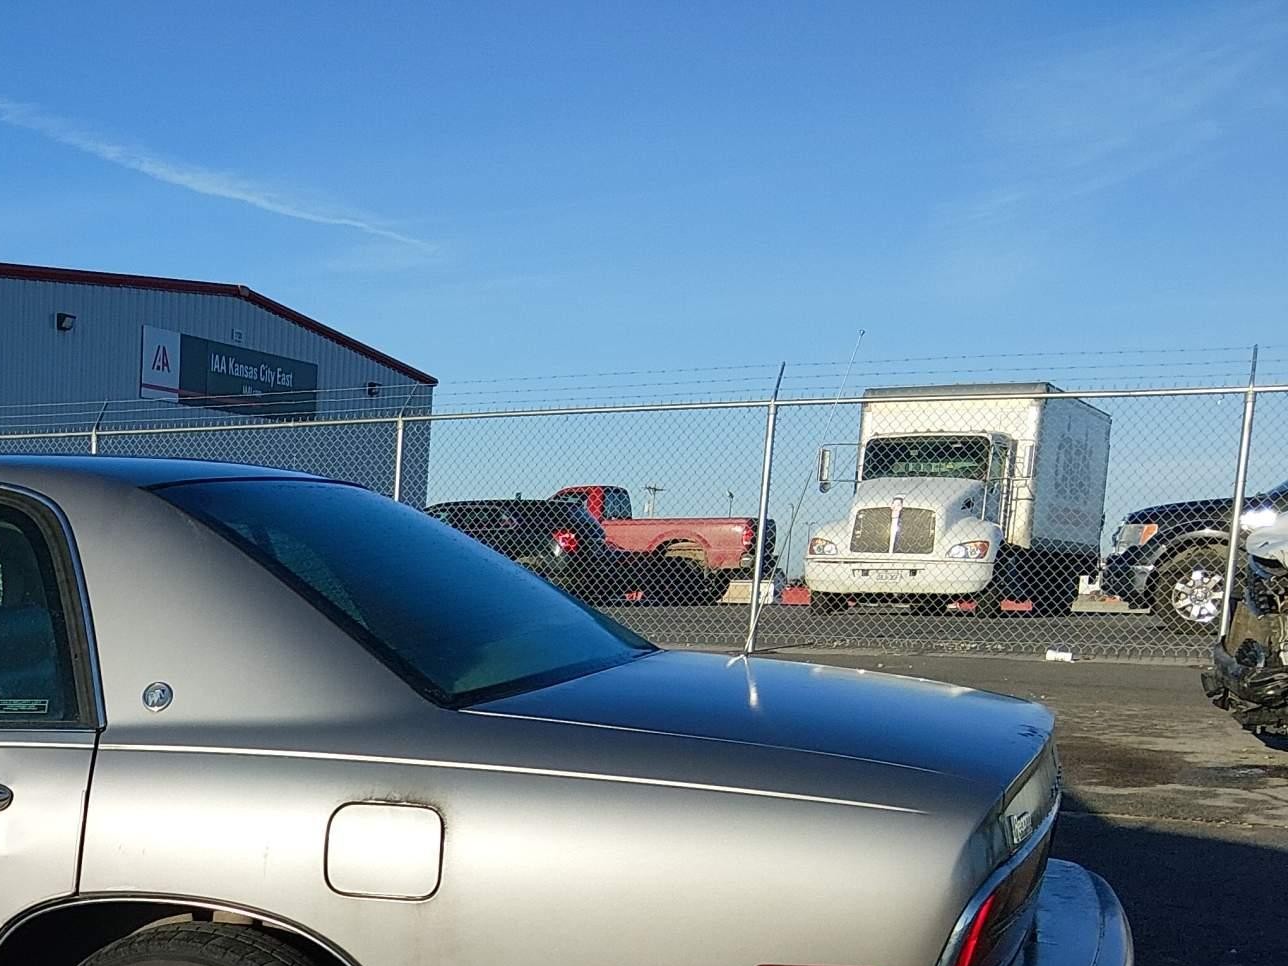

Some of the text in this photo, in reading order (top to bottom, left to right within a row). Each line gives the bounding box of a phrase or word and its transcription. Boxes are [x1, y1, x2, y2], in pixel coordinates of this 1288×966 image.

[211, 353, 293, 388] IAA Kansas City East
